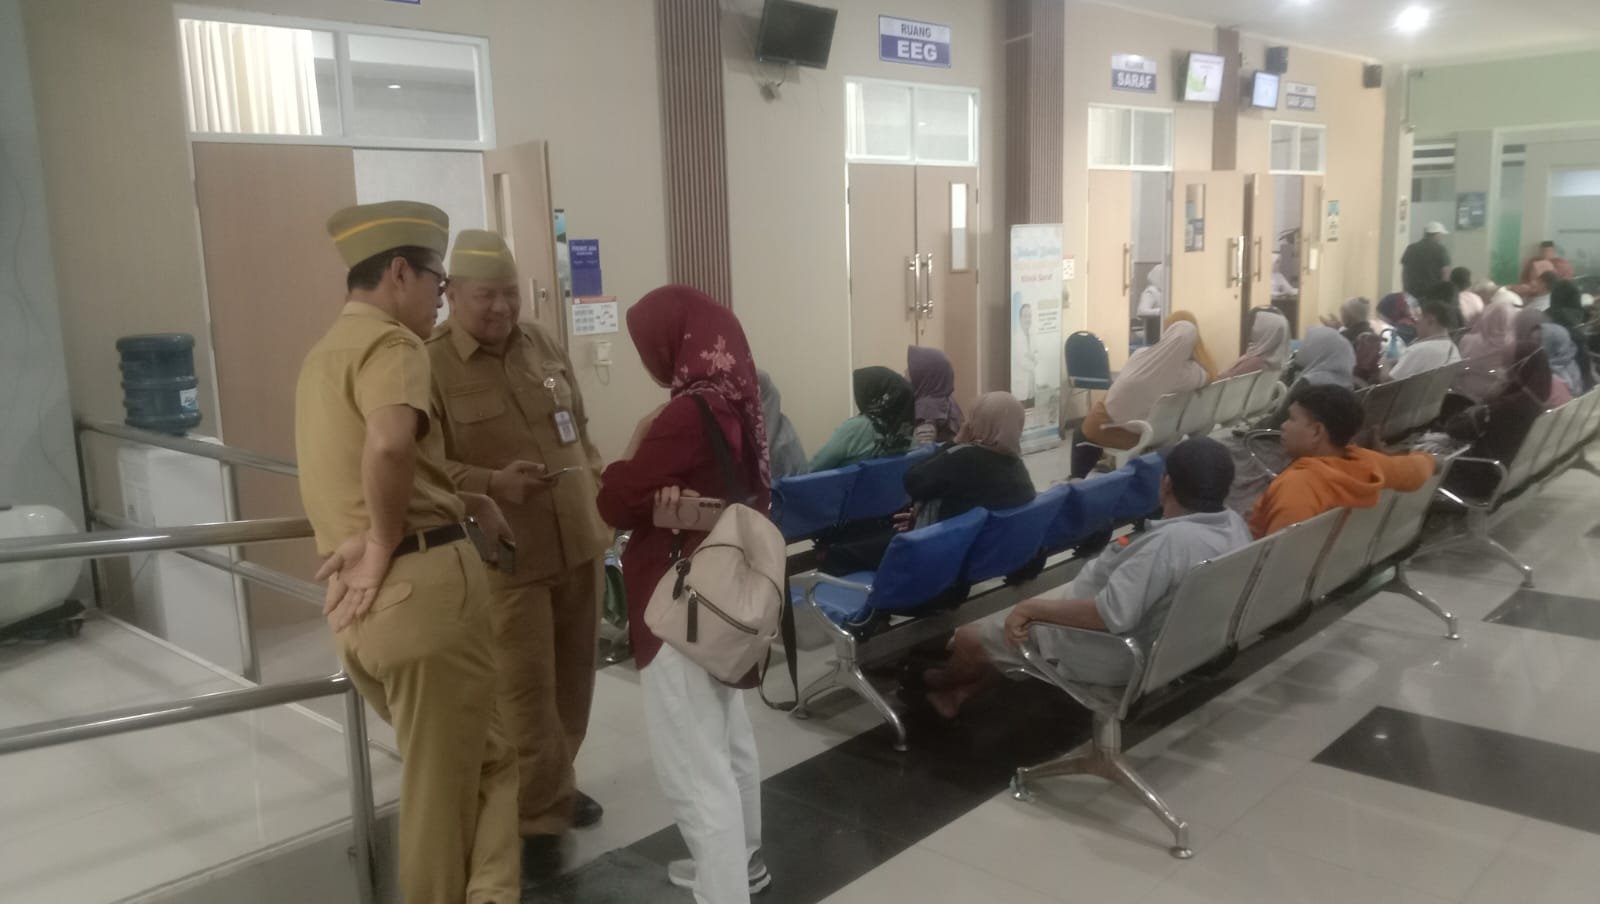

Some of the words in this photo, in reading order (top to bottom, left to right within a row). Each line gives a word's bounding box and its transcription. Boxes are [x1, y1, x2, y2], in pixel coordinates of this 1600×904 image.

[901, 23, 932, 38] RUANG
[897, 40, 938, 61] EEG
[1117, 71, 1152, 89] SARAF
